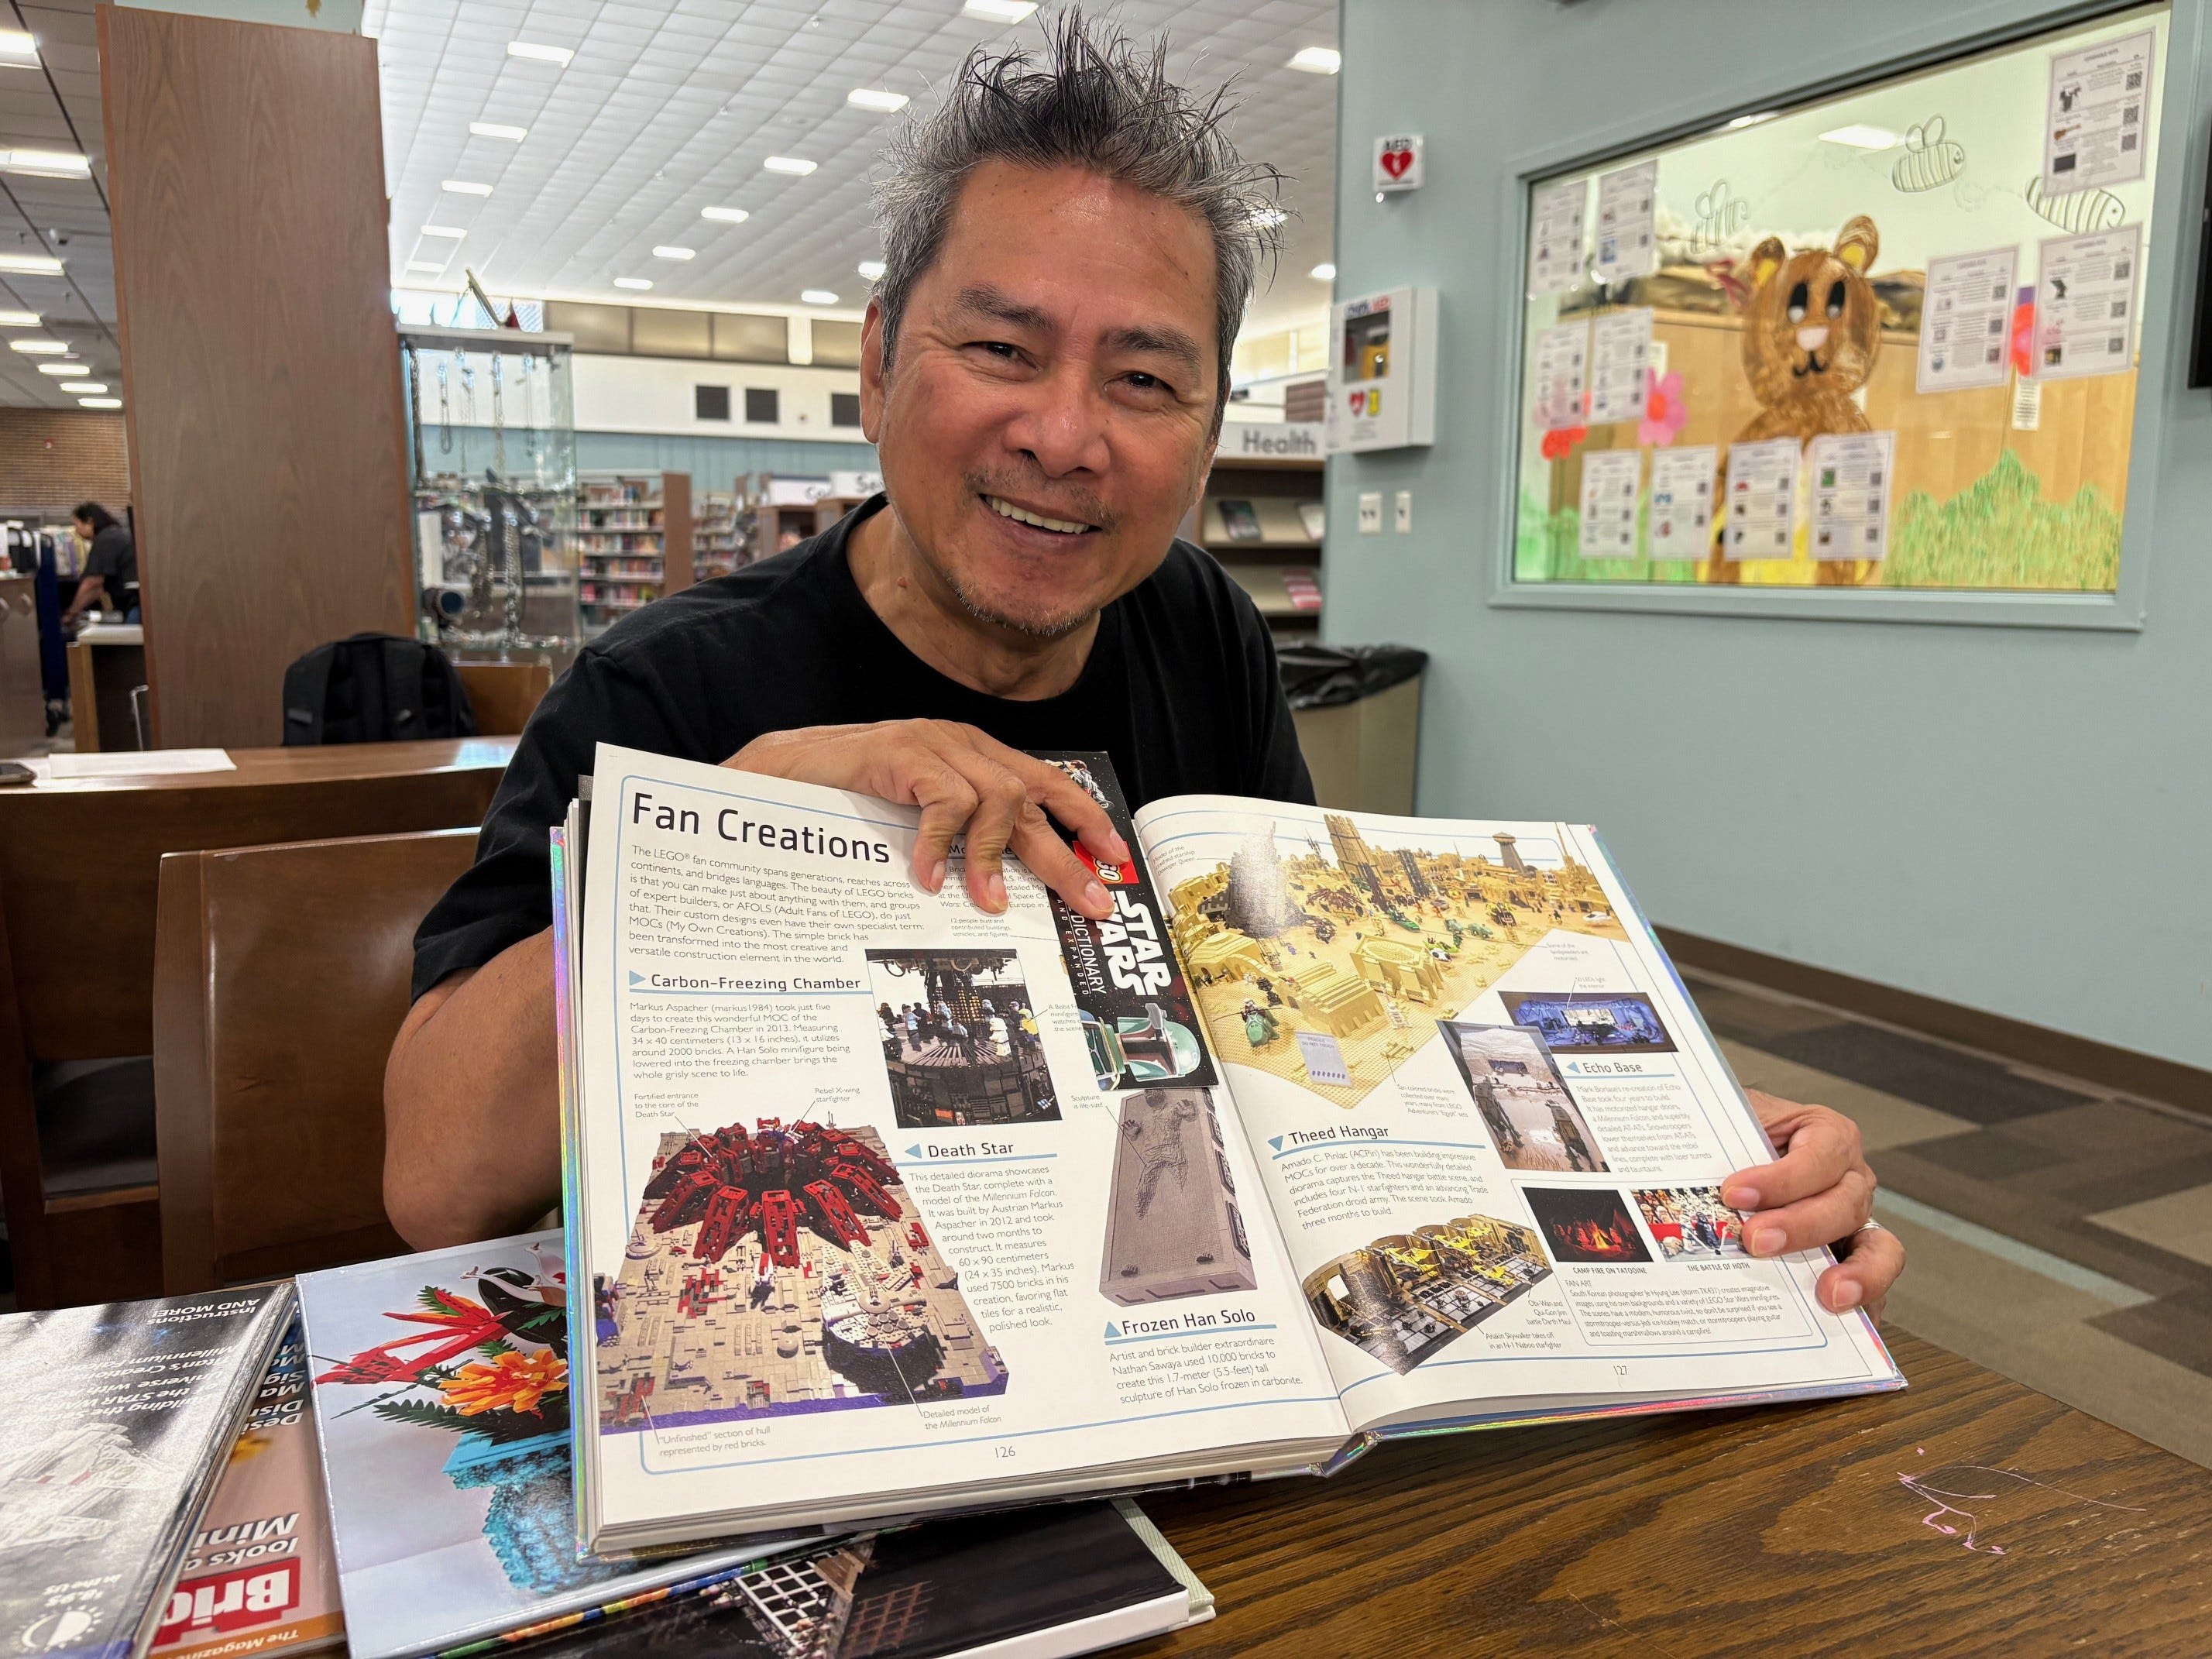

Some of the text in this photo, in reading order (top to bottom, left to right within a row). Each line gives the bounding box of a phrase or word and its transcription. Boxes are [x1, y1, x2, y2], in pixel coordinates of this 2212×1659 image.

[1243, 429, 1315, 455] Health
[633, 792, 889, 863] Fan Creations
[632, 846, 651, 857] The
[692, 856, 706, 866] fan
[709, 860, 761, 875] community
[763, 867, 788, 878] spans
[790, 871, 845, 884] generations,
[847, 878, 881, 887] reaches
[630, 861, 683, 877] continents,
[685, 870, 703, 879] and
[706, 871, 740, 885] bridges
[743, 876, 788, 891] languages.
[789, 881, 809, 892] The
[811, 884, 842, 896] beauty
[856, 888, 885, 898] LEGO
[887, 890, 914, 898] bricks
[629, 931, 654, 942] been
[656, 934, 719, 947] transformed
[722, 940, 741, 949] into
[743, 940, 761, 950] the
[790, 943, 828, 951] creative
[1056, 899, 1088, 995] AND EXPANDED
[1116, 891, 1172, 995] STAR
[1072, 915, 1106, 995] DICTIONARY
[651, 974, 860, 992] Carbon-Freezing Chamber
[630, 1001, 664, 1012] Markus
[665, 1003, 709, 1013] Aspacher
[711, 1004, 773, 1013] (markus1984)
[798, 1004, 814, 1013] just
[630, 1025, 709, 1036] Carbon-Freezing
[710, 1025, 754, 1033] Chamber
[766, 1024, 792, 1032] 2013.
[793, 1023, 839, 1032] Measuring
[1583, 1062, 1643, 1073] Echo Base
[816, 1095, 850, 1104] starfighter
[1288, 1125, 1388, 1145] Theed Hangar
[928, 1142, 1014, 1158] Death Star
[908, 1166, 1049, 1181] This detailed diorama showcases
[1284, 1169, 1314, 1183] MOCs
[1356, 1160, 1384, 1170] decade.
[1387, 1161, 1402, 1171] This
[1403, 1161, 1444, 1171] wonderfully
[1445, 1163, 1472, 1171] detailed
[948, 1240, 1047, 1255] construct. It measures
[146, 1307, 255, 1325] Instructions
[153, 1298, 260, 1318] AND MORE!
[988, 1317, 1053, 1332] polished look.
[1121, 1308, 1255, 1334] Frozen Han Solo
[129, 1345, 236, 1365] Millennium
[1109, 1337, 1275, 1362] Artist and brick builder extraordinaire
[137, 1370, 223, 1389] Universe
[1613, 1365, 1627, 1376] 127
[100, 1393, 155, 1405] STAR
[152, 1387, 190, 1399] the
[1119, 1391, 1163, 1404] sculpture
[1164, 1386, 1174, 1397] of
[1176, 1386, 1197, 1396] Han
[1197, 1382, 1219, 1393] Solo
[1220, 1380, 1250, 1390] frozen
[1261, 1376, 1304, 1386] carbonite.
[87, 1406, 125, 1417] the
[922, 1404, 990, 1419] Detailed model of
[925, 1415, 1001, 1430] the Millennium Falcon
[713, 1430, 744, 1439] section
[744, 1427, 754, 1436] of
[755, 1425, 771, 1435] hull
[659, 1438, 767, 1458] represented by red bricks.
[994, 1445, 1015, 1458] 126
[211, 1537, 298, 1568] looks
[267, 1630, 298, 1643] The
